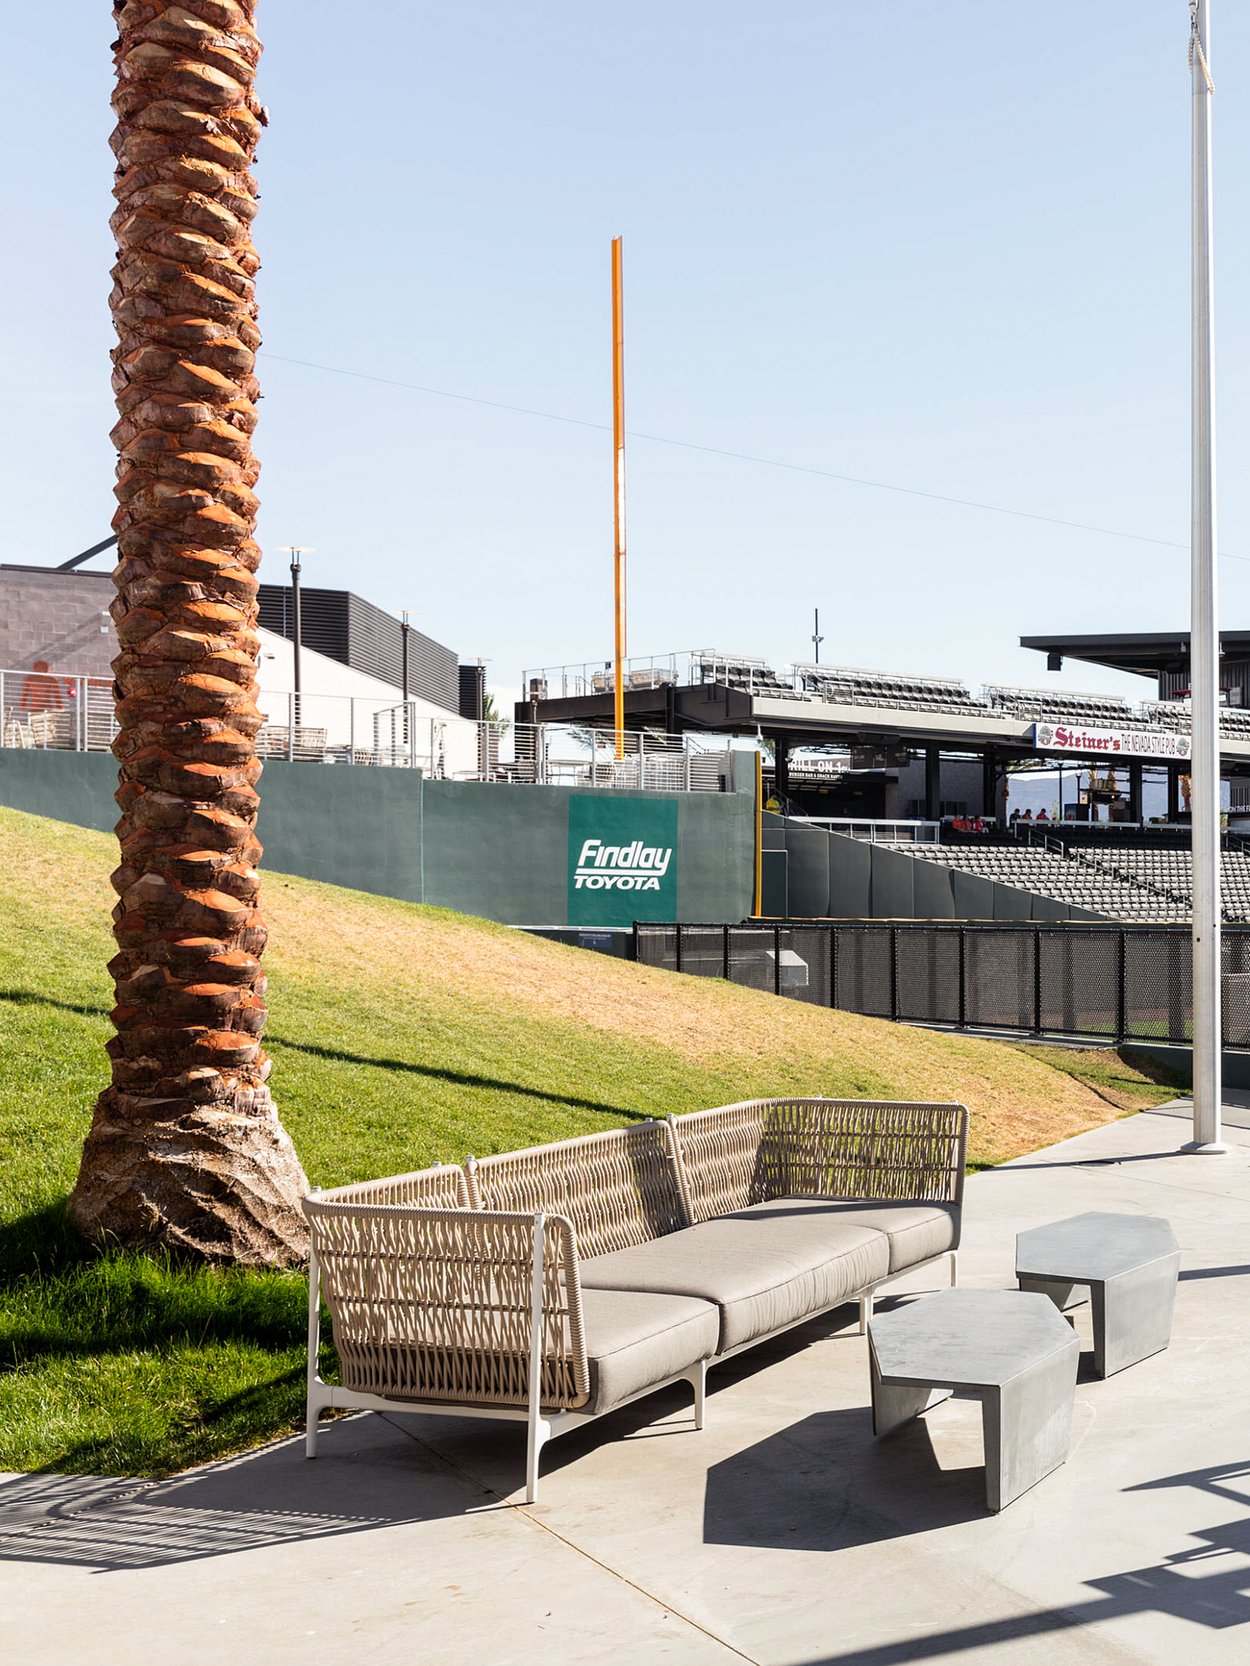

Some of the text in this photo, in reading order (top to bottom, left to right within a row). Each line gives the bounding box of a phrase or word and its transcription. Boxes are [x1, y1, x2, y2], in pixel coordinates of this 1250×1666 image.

[1053, 727, 1176, 755] Steiner's THE NEVADA STYLE PUB
[788, 759, 815, 772] RILL
[818, 760, 832, 772] ON
[577, 839, 673, 877] Findlay
[573, 875, 661, 891] TOYOTA
